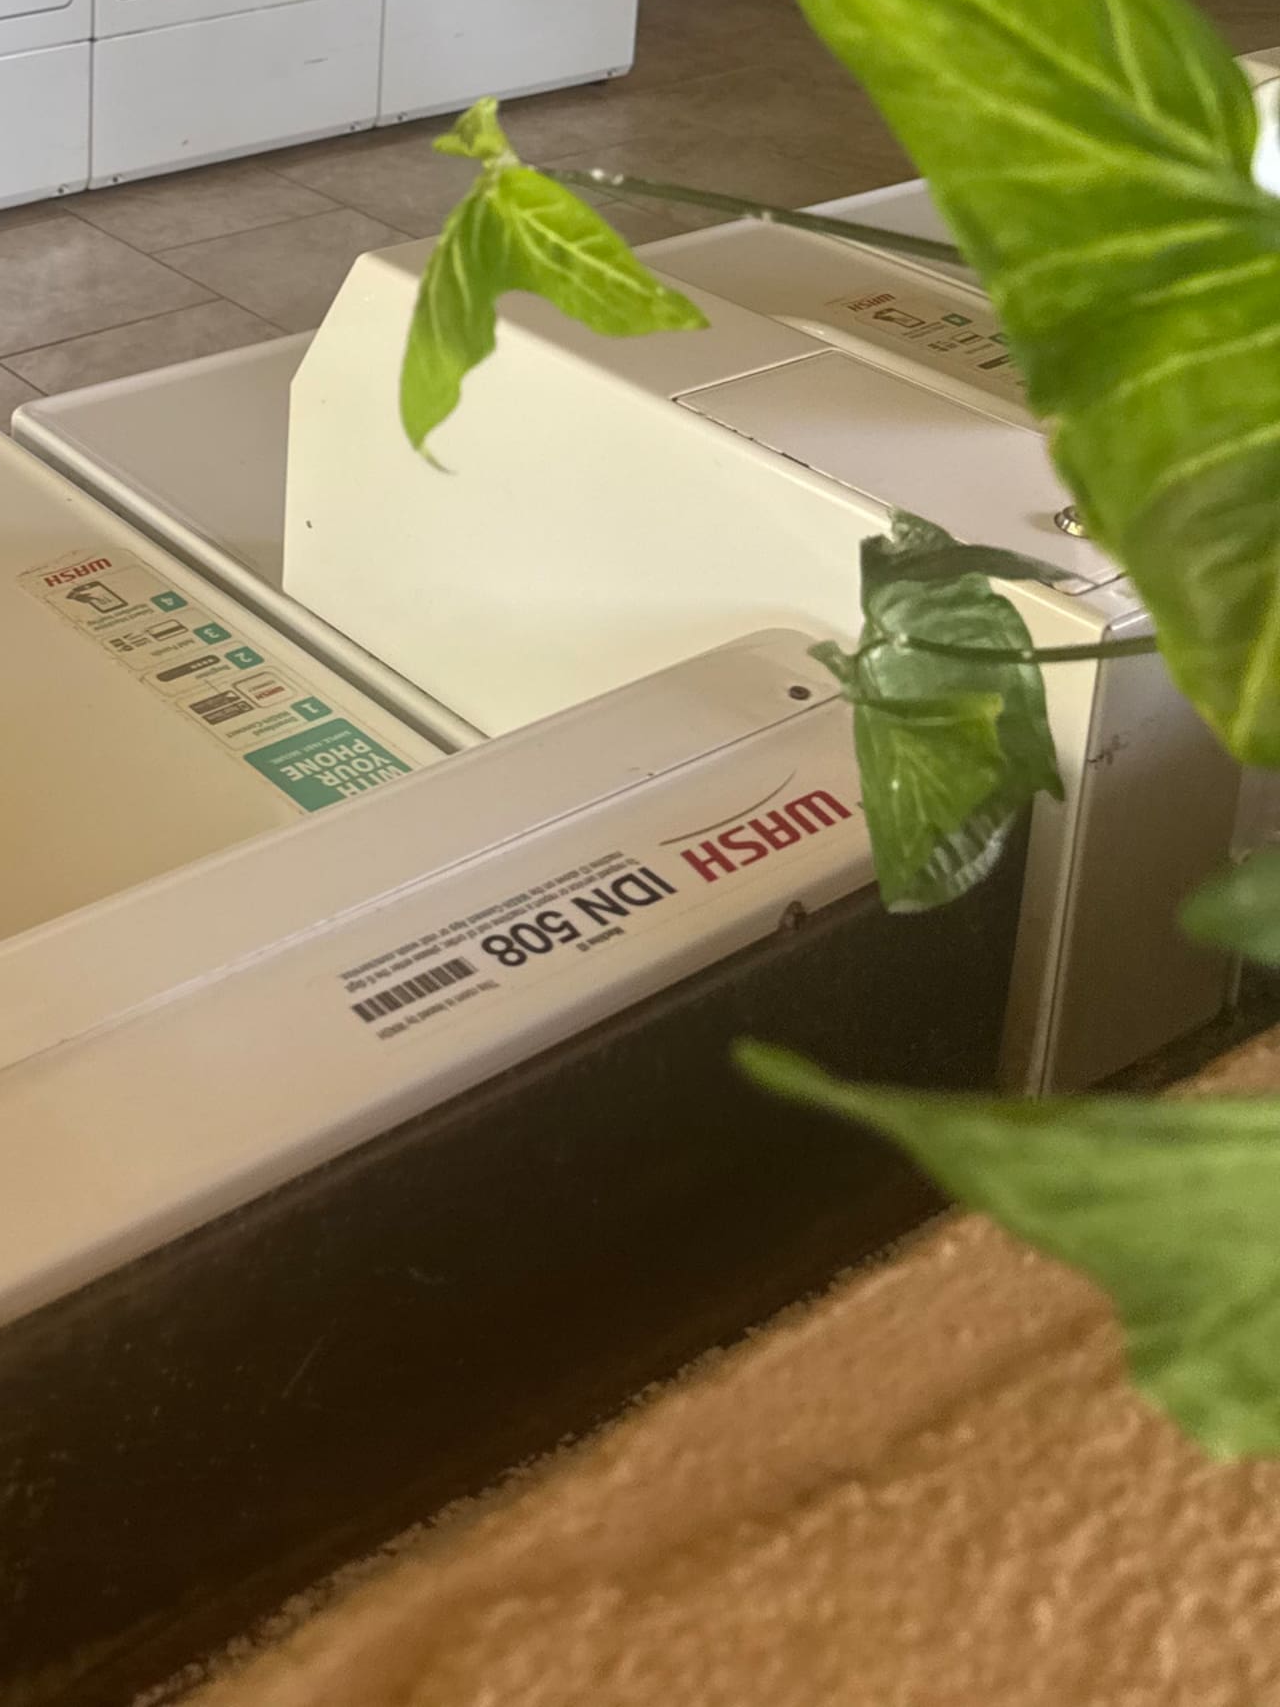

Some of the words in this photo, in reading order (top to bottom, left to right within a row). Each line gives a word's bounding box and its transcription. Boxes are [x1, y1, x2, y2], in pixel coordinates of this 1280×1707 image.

[44, 558, 112, 587] WASH
[161, 597, 175, 606] 4
[203, 628, 219, 639] 3
[234, 652, 252, 663] 2
[301, 703, 318, 714] 1
[280, 738, 373, 782] PHONE
[314, 753, 392, 787] YOUR
[680, 790, 853, 882] WASH
[573, 866, 678, 927] IDN
[482, 910, 581, 967] 508
